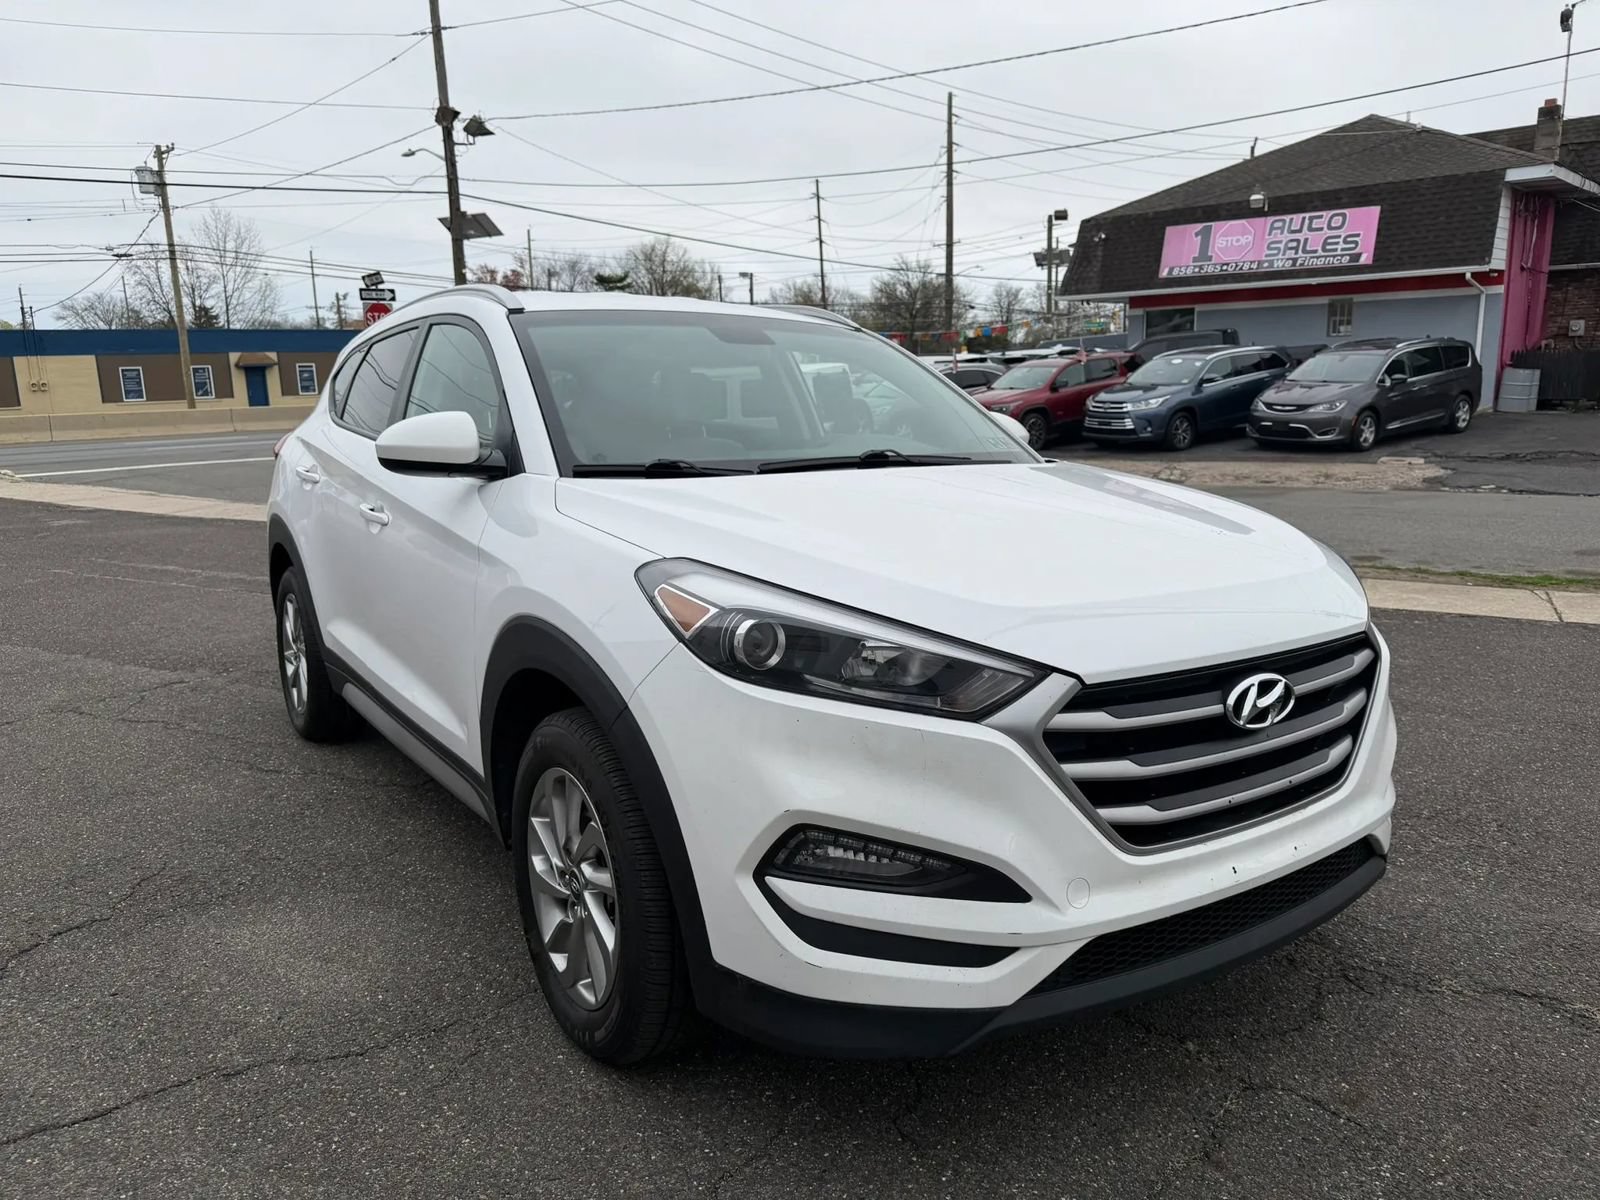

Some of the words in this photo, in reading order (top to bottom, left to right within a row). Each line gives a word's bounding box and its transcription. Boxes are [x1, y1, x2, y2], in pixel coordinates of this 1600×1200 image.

[1267, 211, 1348, 237] AUTO
[1191, 223, 1214, 264] 1
[1217, 235, 1252, 247] STOP
[1264, 233, 1361, 258] SALES
[1273, 258, 1293, 268] We
[1296, 255, 1350, 267] Finance
[367, 312, 388, 325] ST
